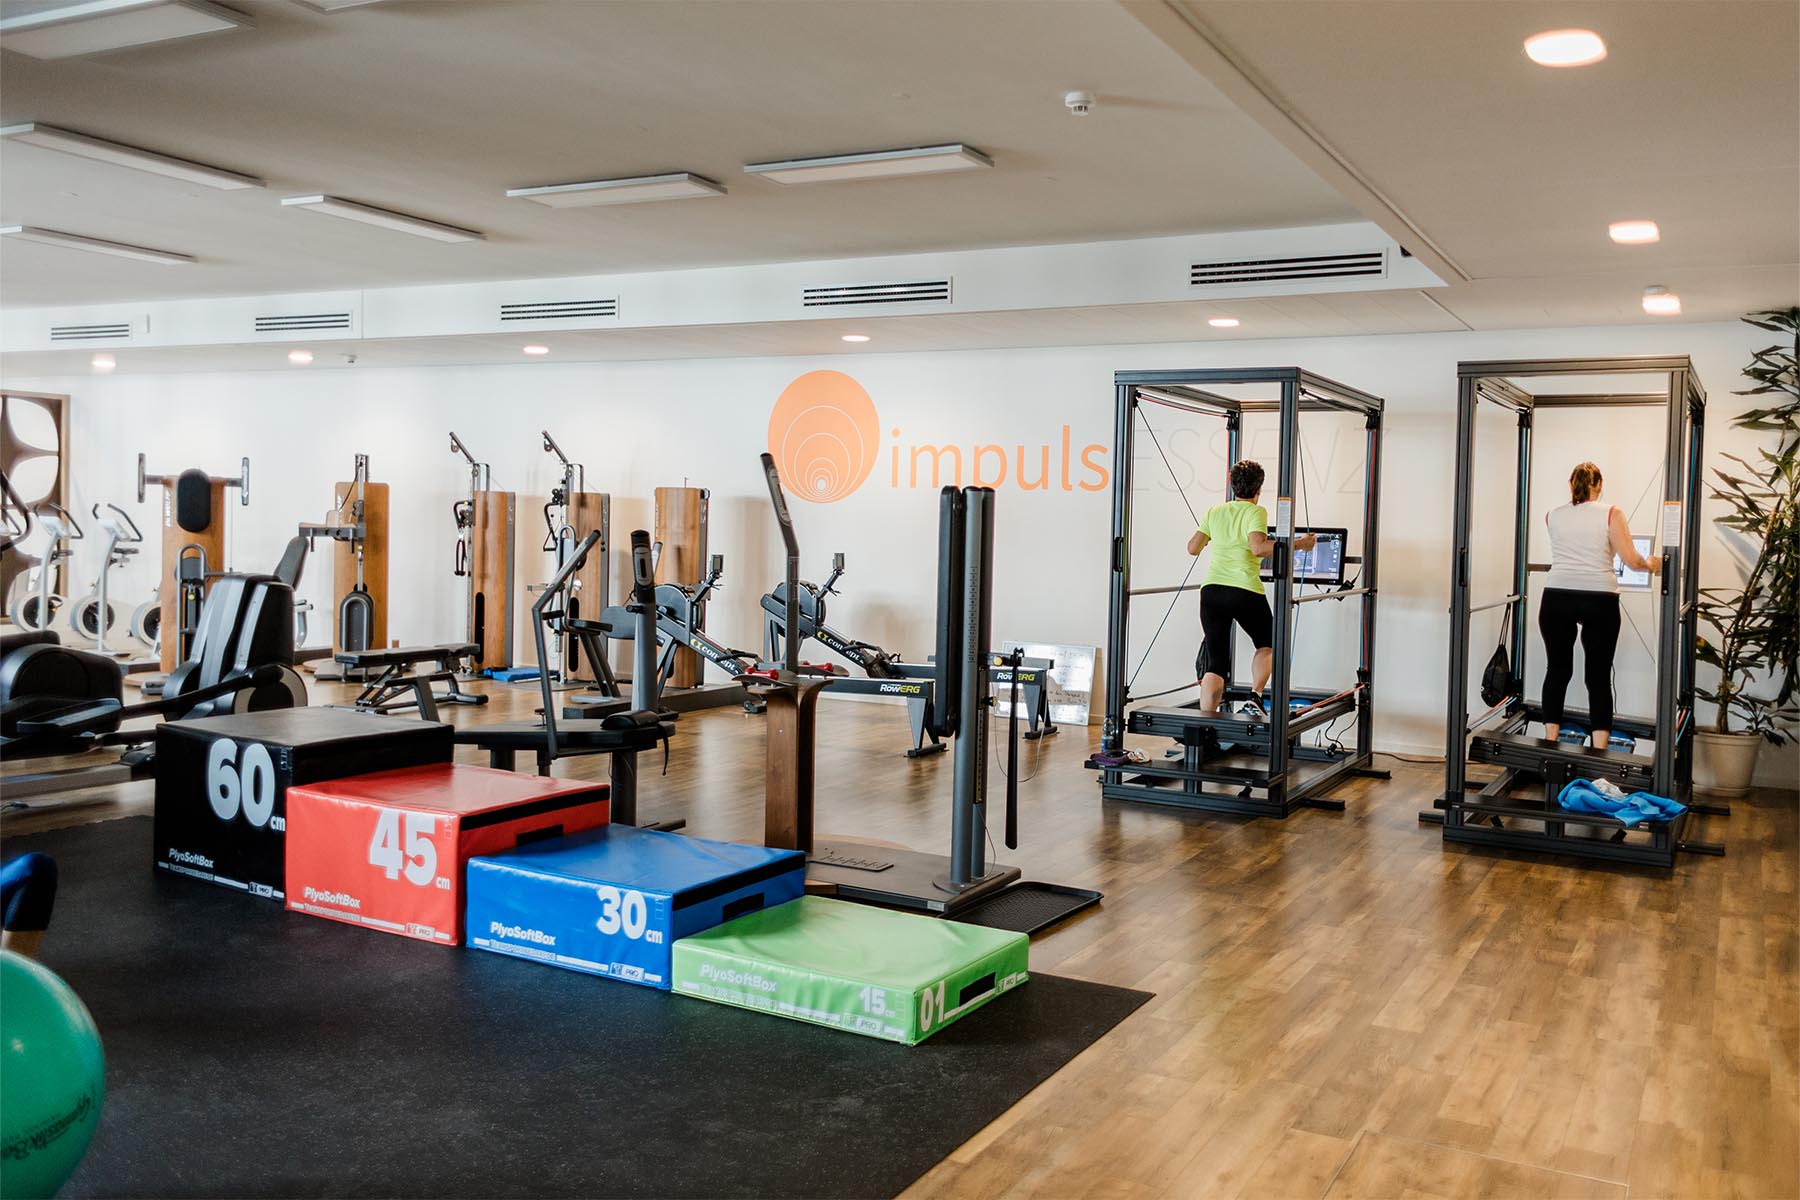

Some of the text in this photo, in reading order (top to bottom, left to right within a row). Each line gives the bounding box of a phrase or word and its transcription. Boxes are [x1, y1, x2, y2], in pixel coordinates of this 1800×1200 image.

[890, 423, 1110, 492] impuls
[207, 737, 286, 832] 60 cm
[368, 808, 438, 886] 45
[435, 876, 451, 890] cm
[303, 886, 361, 909] PlyoSoftBox
[596, 885, 647, 940] 30
[645, 928, 663, 945] cm
[490, 921, 556, 946] PlyoSoftBox
[700, 963, 777, 993] PlyoSoftBox
[859, 985, 887, 1016] 15
[920, 979, 946, 1032] 01
